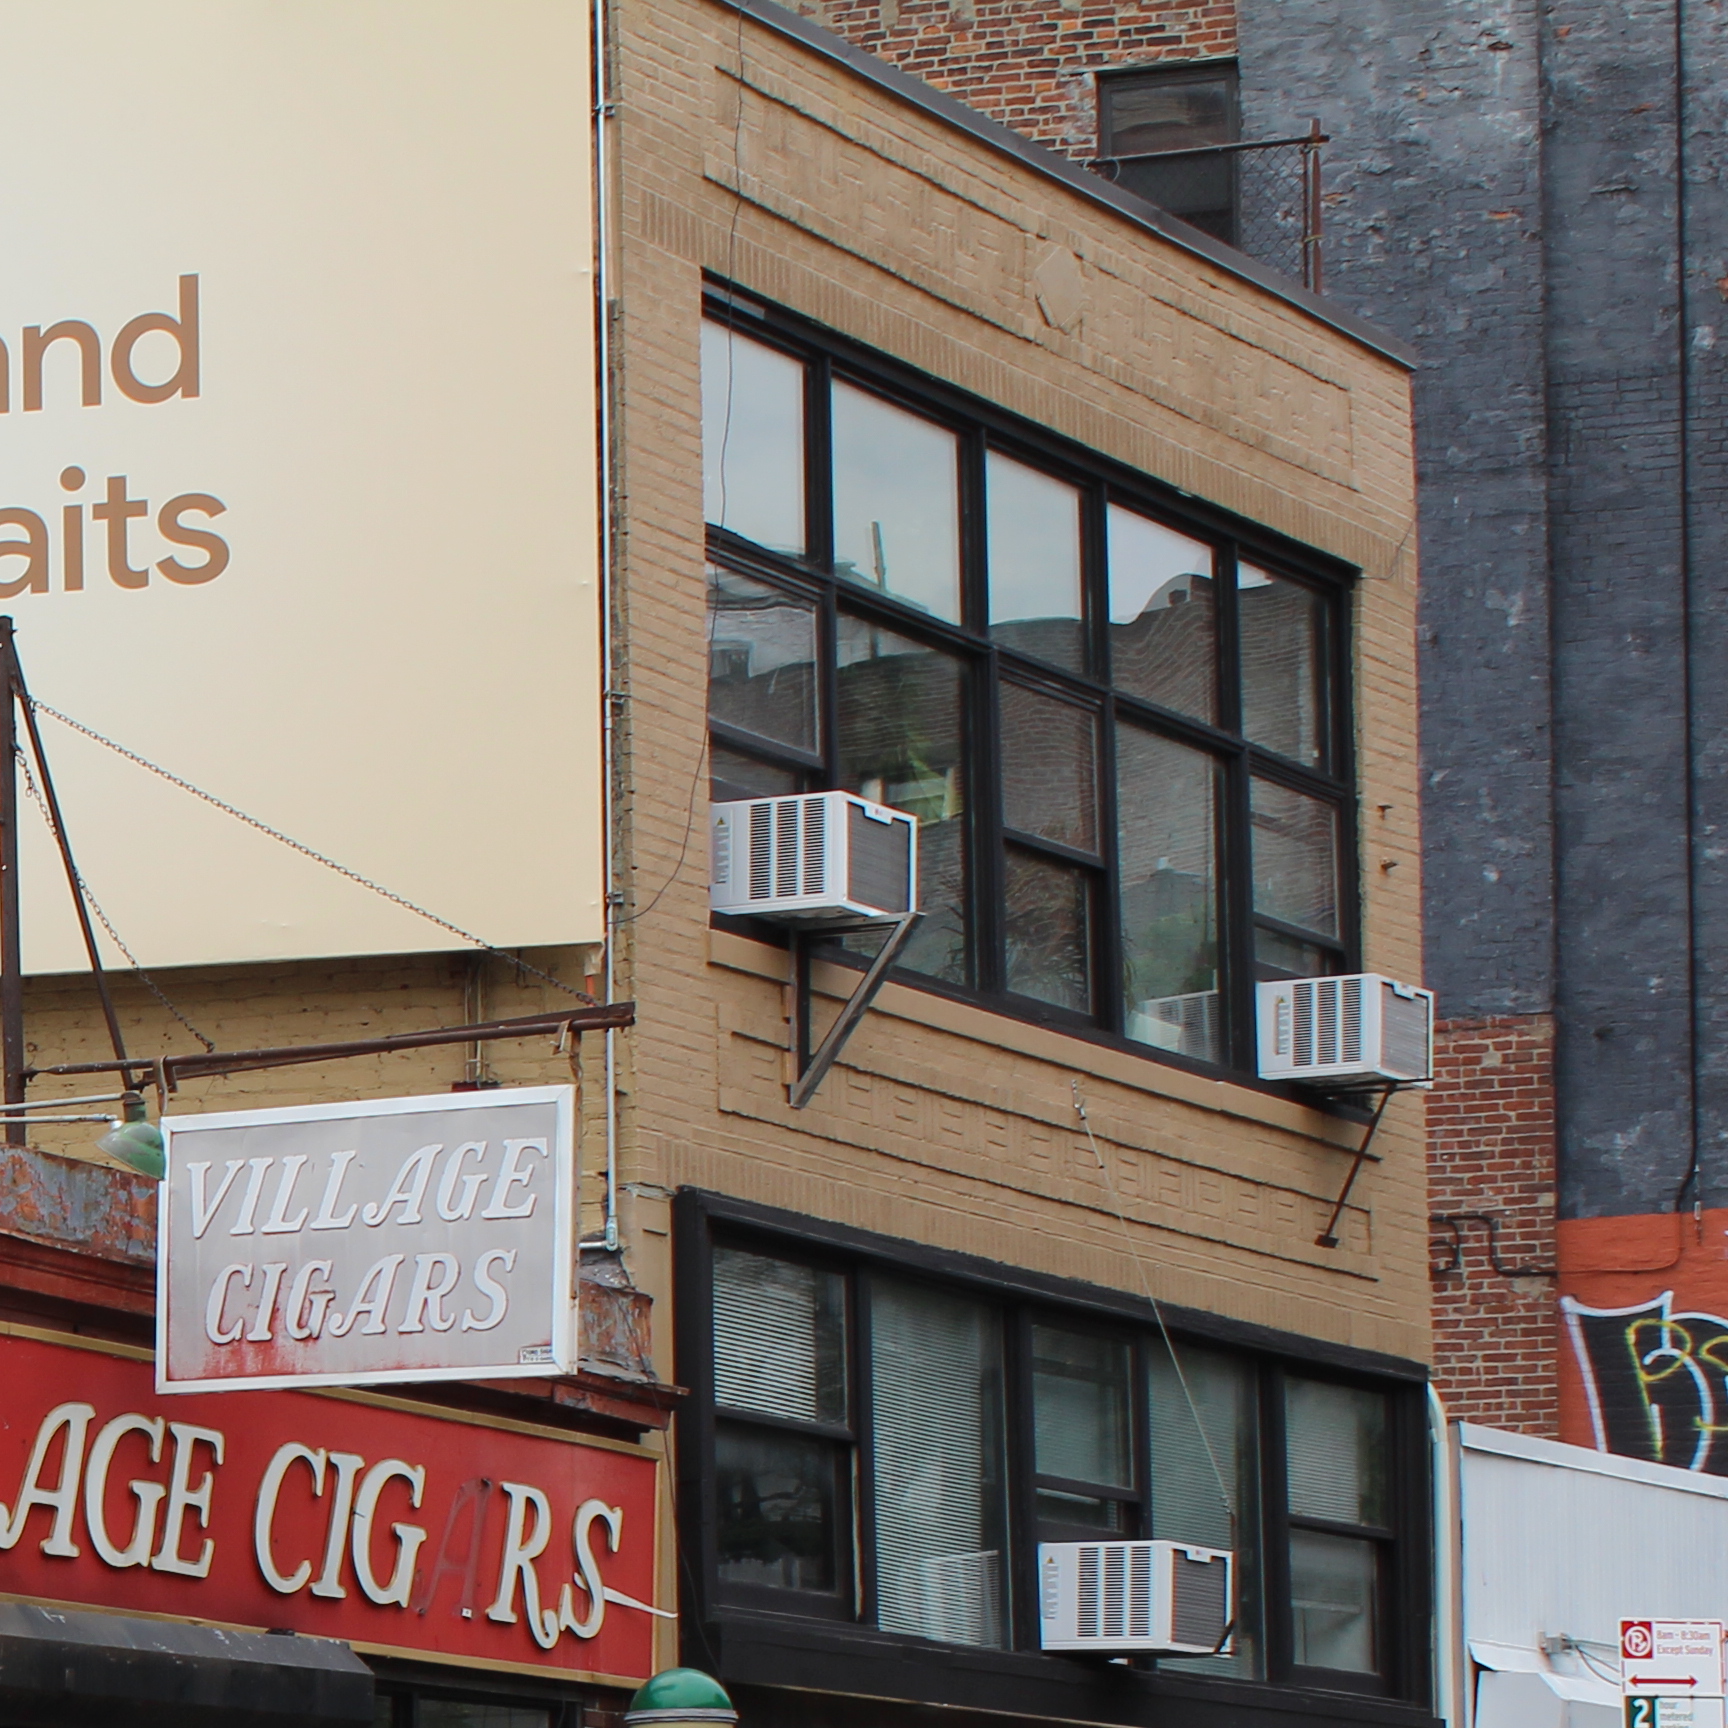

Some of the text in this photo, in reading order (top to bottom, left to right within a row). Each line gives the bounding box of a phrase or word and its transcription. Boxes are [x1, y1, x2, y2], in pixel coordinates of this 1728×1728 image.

[185, 1136, 548, 1240] VILLAGE
[205, 1248, 517, 1345] CIGARS
[1657, 1629, 1711, 1640] 8am 8:30am
[1656, 1645, 1713, 1656] Except Sunday
[1633, 1699, 1677, 1728] 2 hour
[1660, 1712, 1693, 1721] metered
